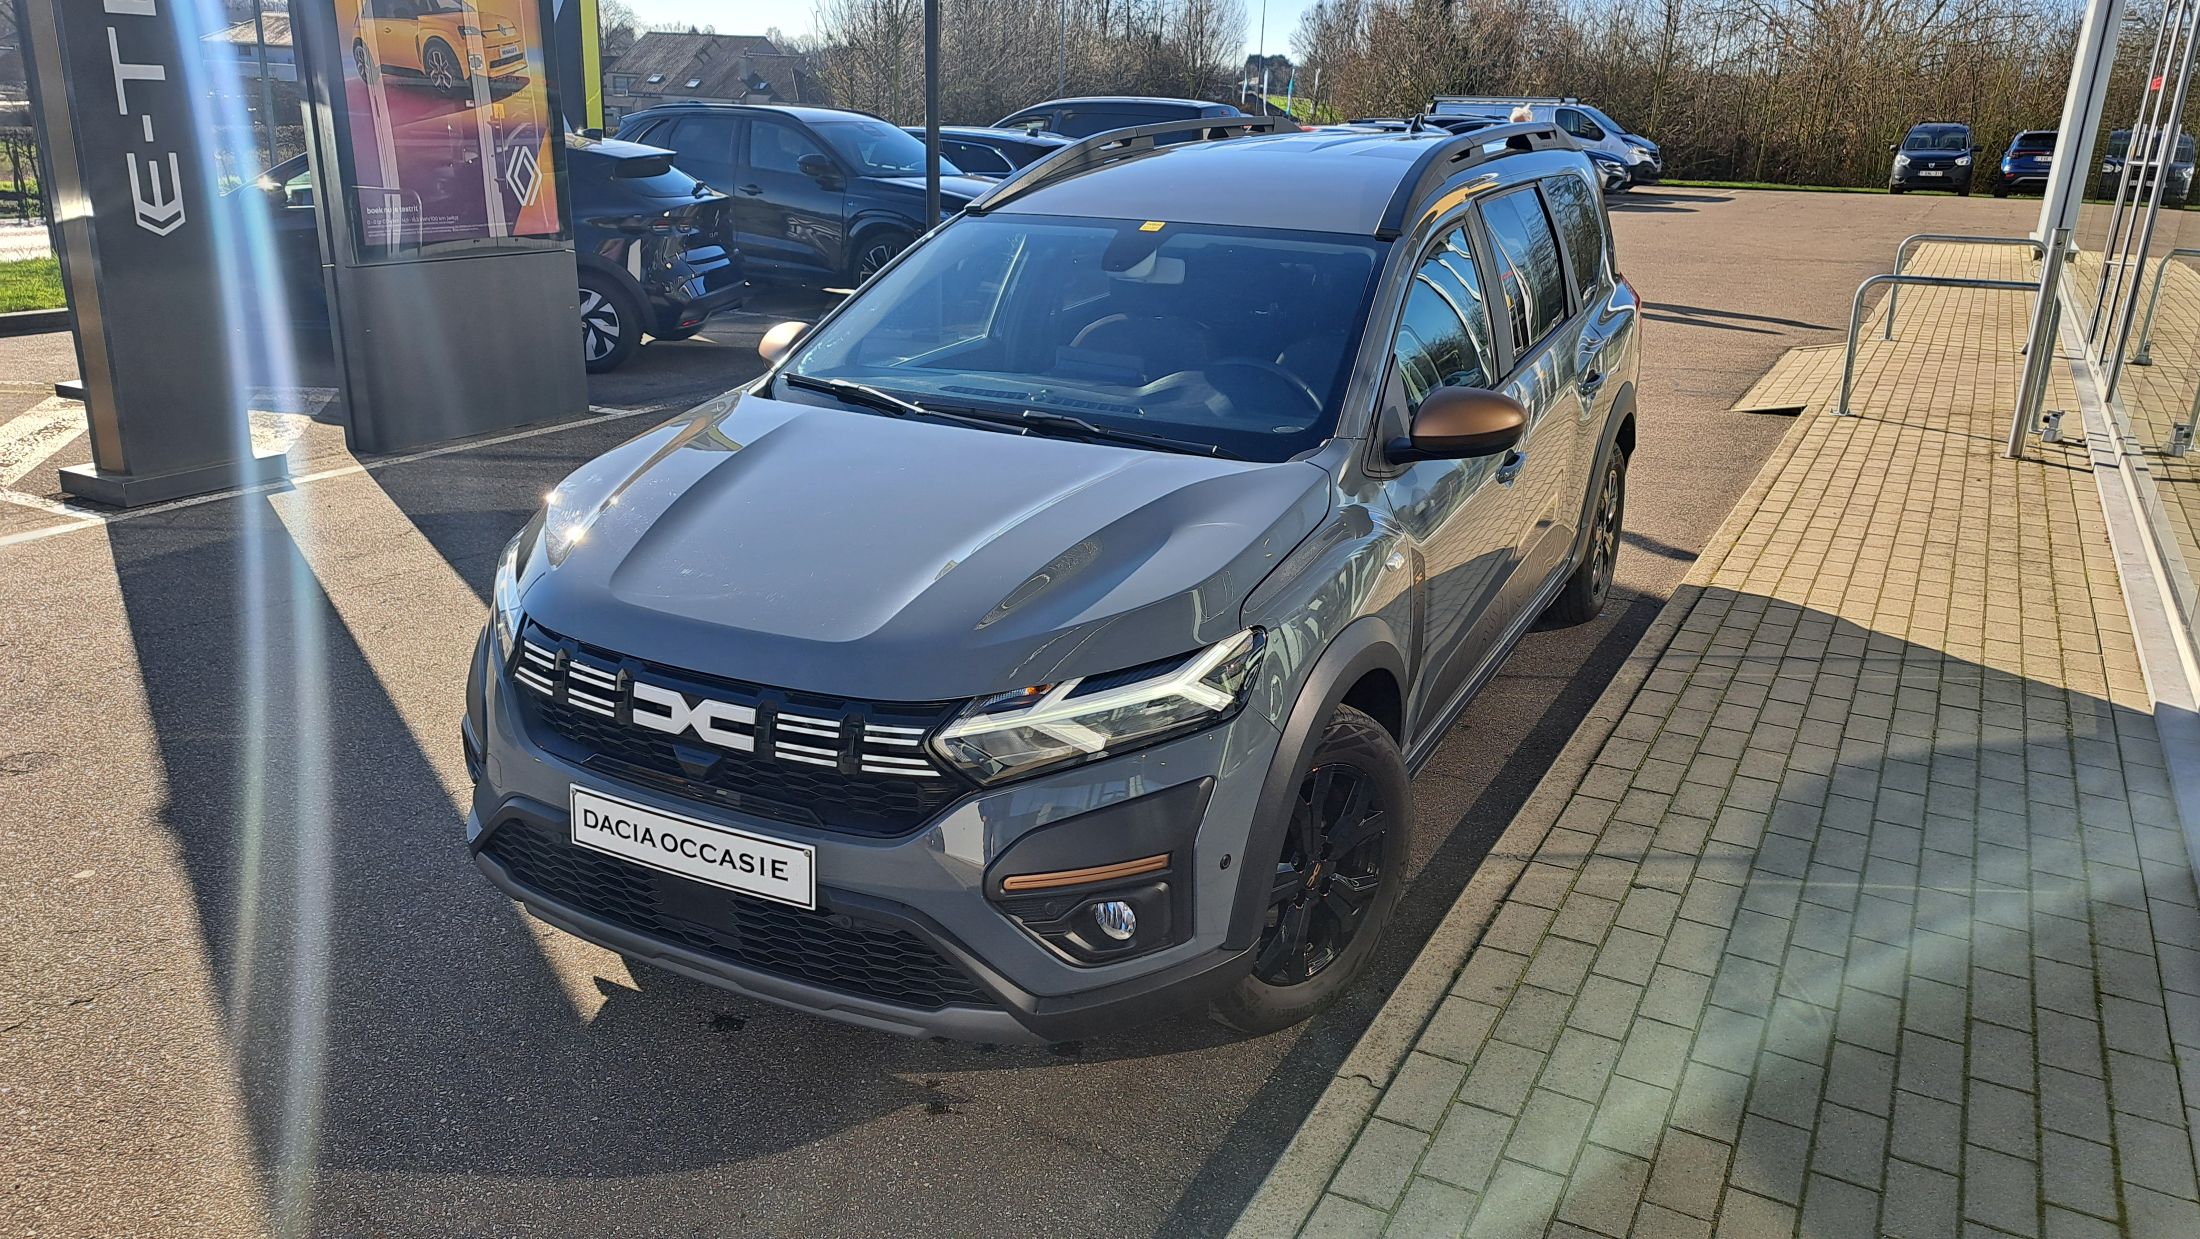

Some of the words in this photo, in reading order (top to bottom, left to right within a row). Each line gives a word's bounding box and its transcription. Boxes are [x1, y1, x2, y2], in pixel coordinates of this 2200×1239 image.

[367, 205, 383, 214] boek
[583, 808, 657, 848] DACIA
[660, 833, 789, 881] OCCASIE
